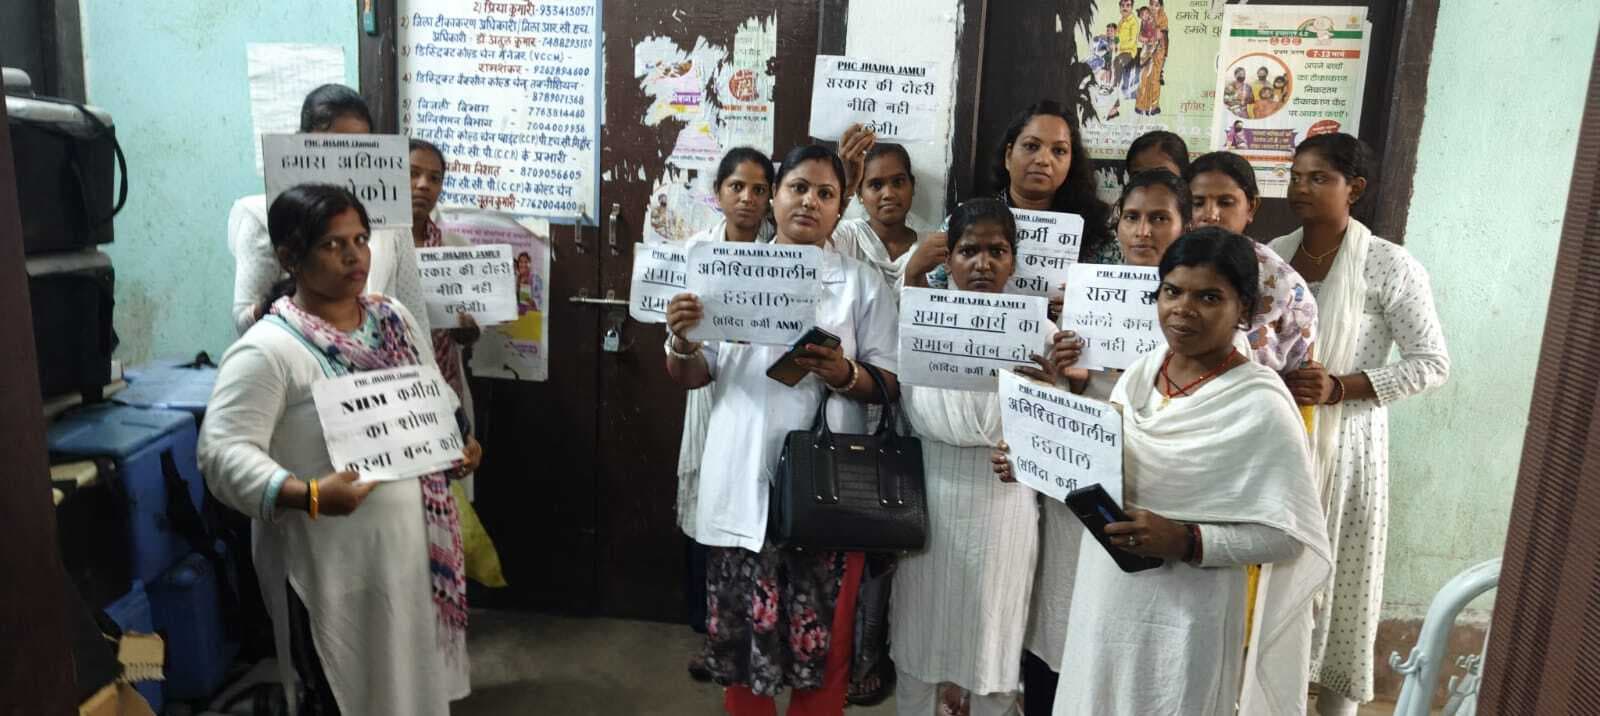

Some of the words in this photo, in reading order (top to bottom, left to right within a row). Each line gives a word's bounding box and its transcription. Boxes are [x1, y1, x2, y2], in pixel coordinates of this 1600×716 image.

[837, 60, 859, 71] PHC
[861, 62, 896, 74] JHAJHA
[826, 77, 868, 91] सरकार
[876, 78, 893, 93] की
[901, 80, 935, 96] दोहरी
[847, 97, 878, 113] नीति
[280, 153, 328, 170] हमारा
[337, 152, 404, 170] अधिकार
[1017, 226, 1049, 244] कर्मी
[1057, 232, 1080, 247] का
[733, 247, 770, 258] JHAJHA
[1024, 253, 1066, 270] करना
[459, 262, 475, 277] की
[437, 281, 463, 297] नीति
[1086, 286, 1129, 304] राज्य
[952, 296, 992, 306] JHAJHA
[913, 309, 959, 327] समान
[970, 312, 1008, 332] कार्य
[1019, 319, 1040, 333] का
[911, 336, 954, 354] समान
[964, 339, 1002, 358] वेतन
[340, 393, 388, 415] NHM
[365, 421, 390, 439] का
[398, 410, 439, 431] शोषण
